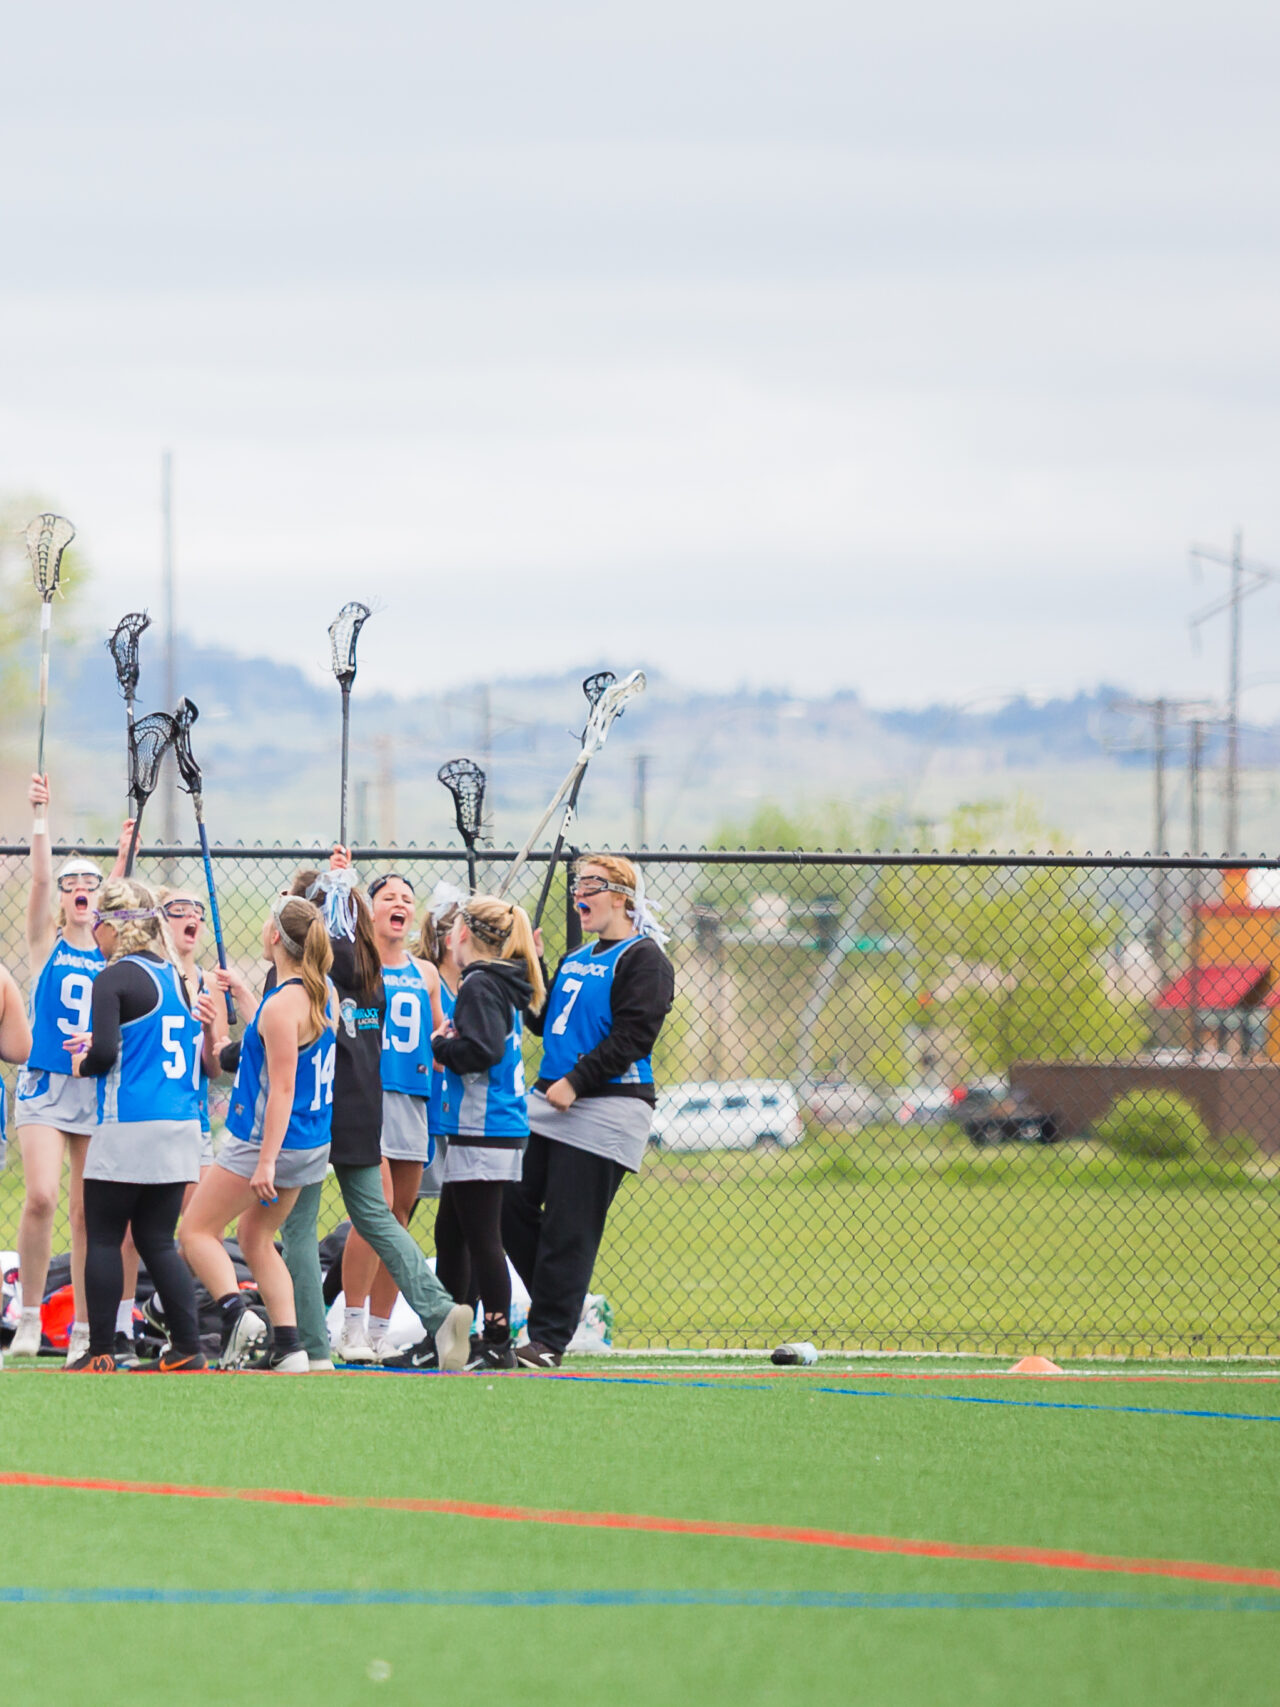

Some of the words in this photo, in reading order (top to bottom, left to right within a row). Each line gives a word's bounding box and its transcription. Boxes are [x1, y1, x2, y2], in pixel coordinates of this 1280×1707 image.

[57, 973, 93, 1035] 9
[552, 977, 584, 1035] 7
[310, 1043, 337, 1111] 14
